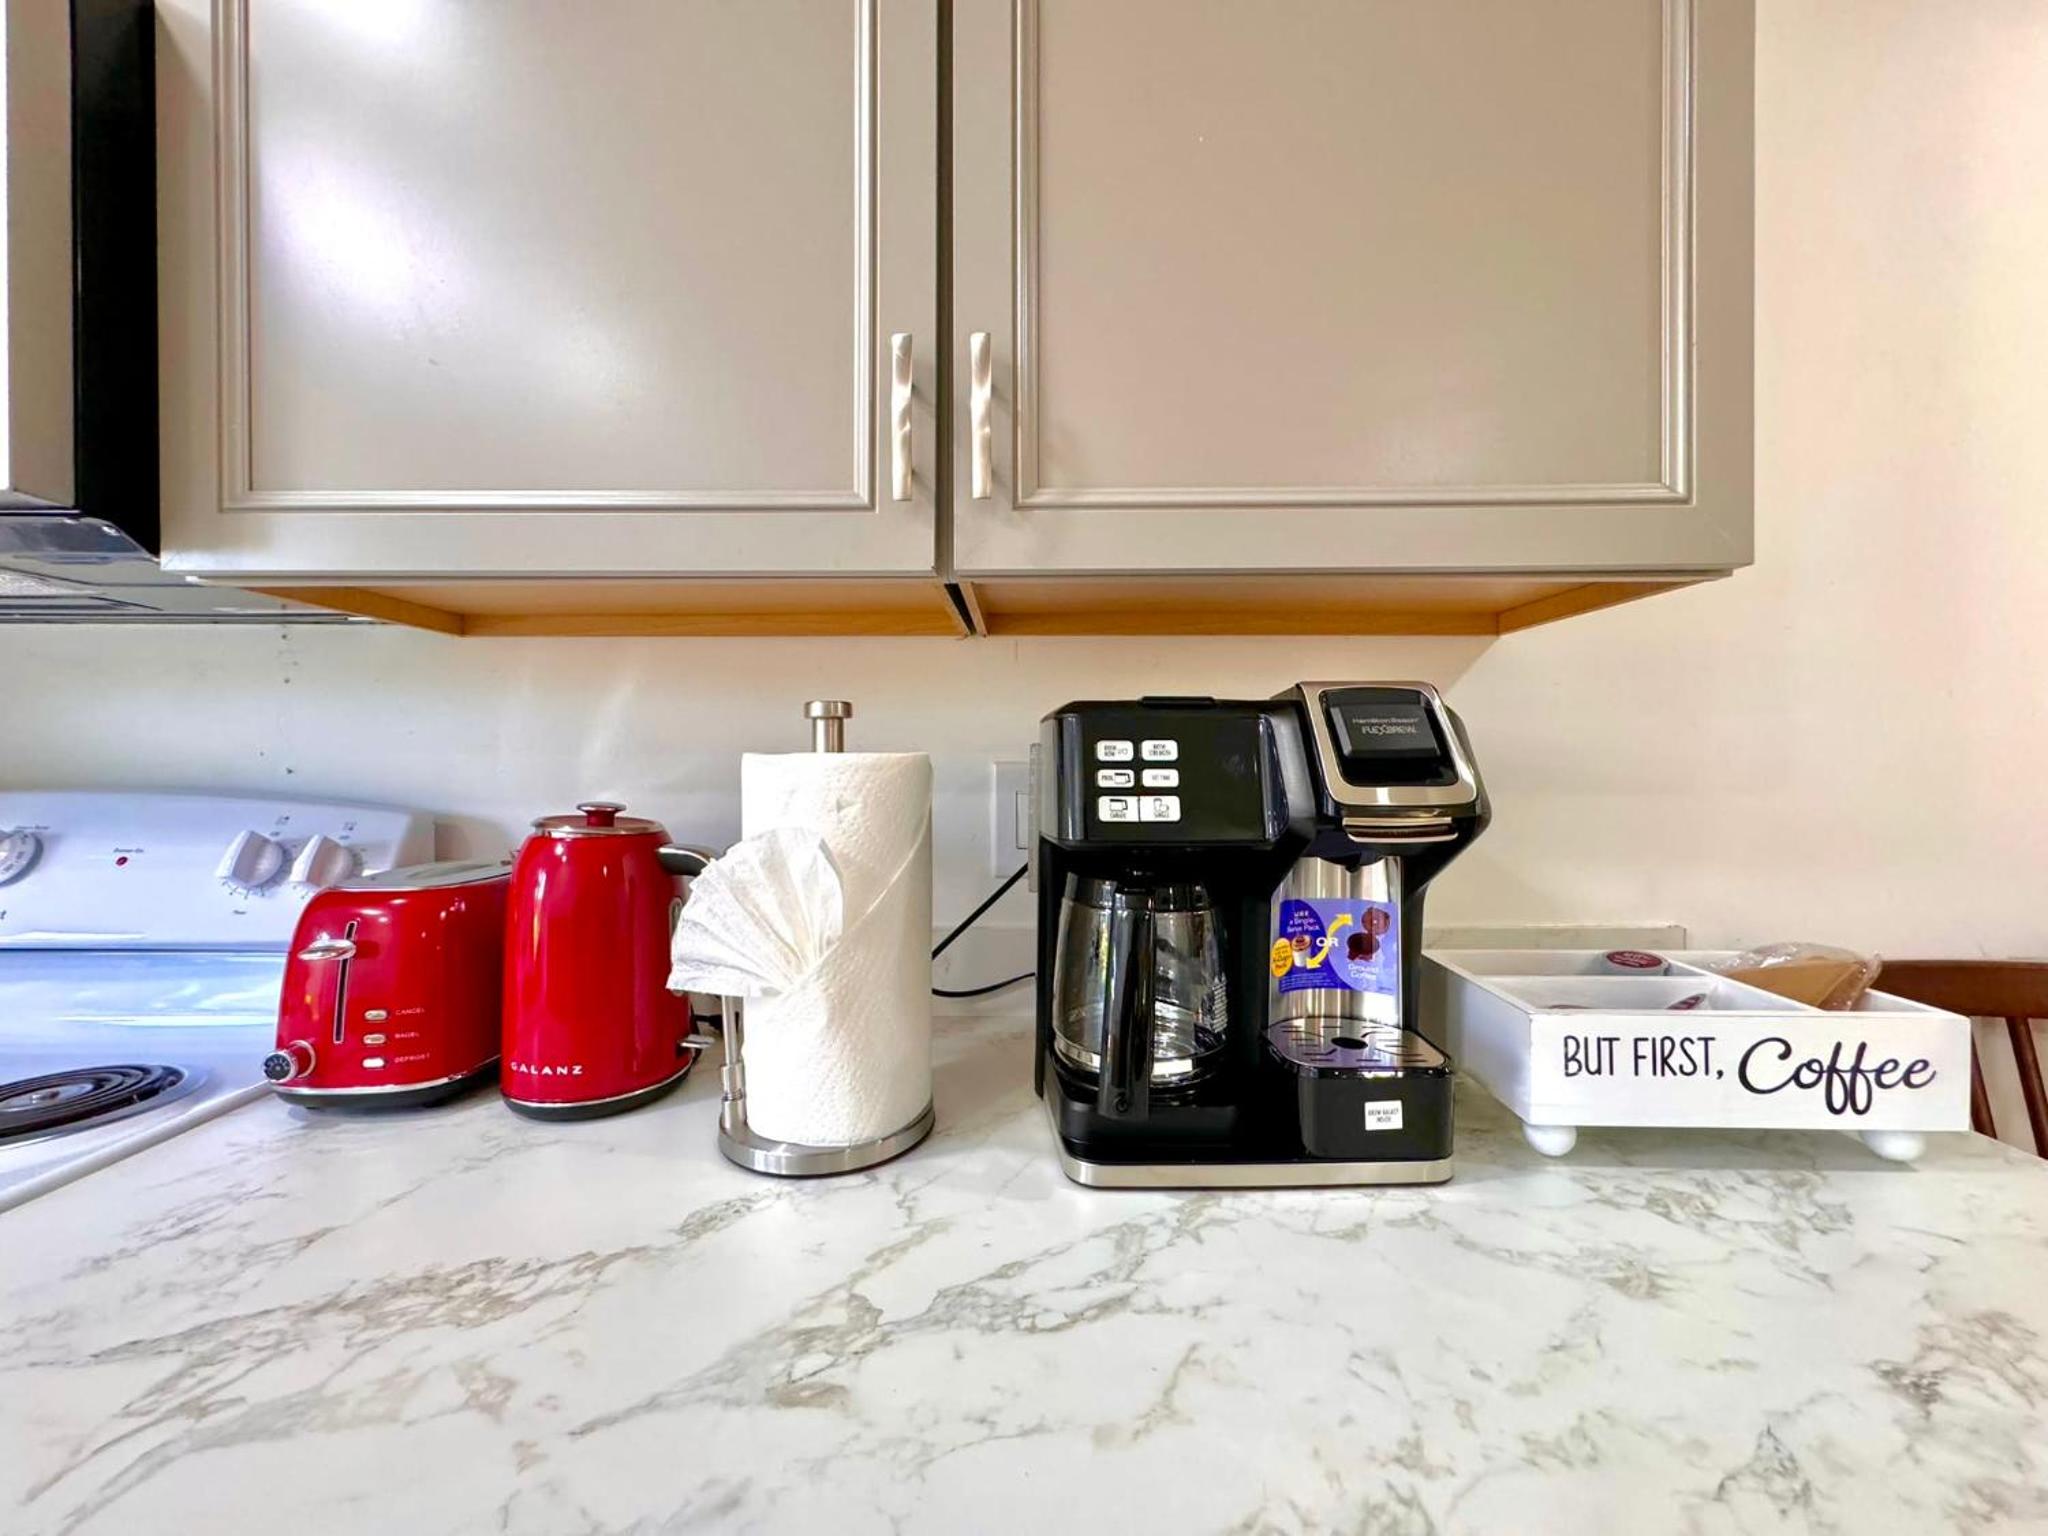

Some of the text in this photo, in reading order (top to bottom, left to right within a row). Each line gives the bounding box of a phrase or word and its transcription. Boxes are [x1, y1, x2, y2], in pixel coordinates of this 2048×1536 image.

[1316, 937, 1339, 947] OR
[510, 1061, 584, 1076] GALANZ
[1563, 1035, 1937, 1116] BUT FIRST, Coffee
